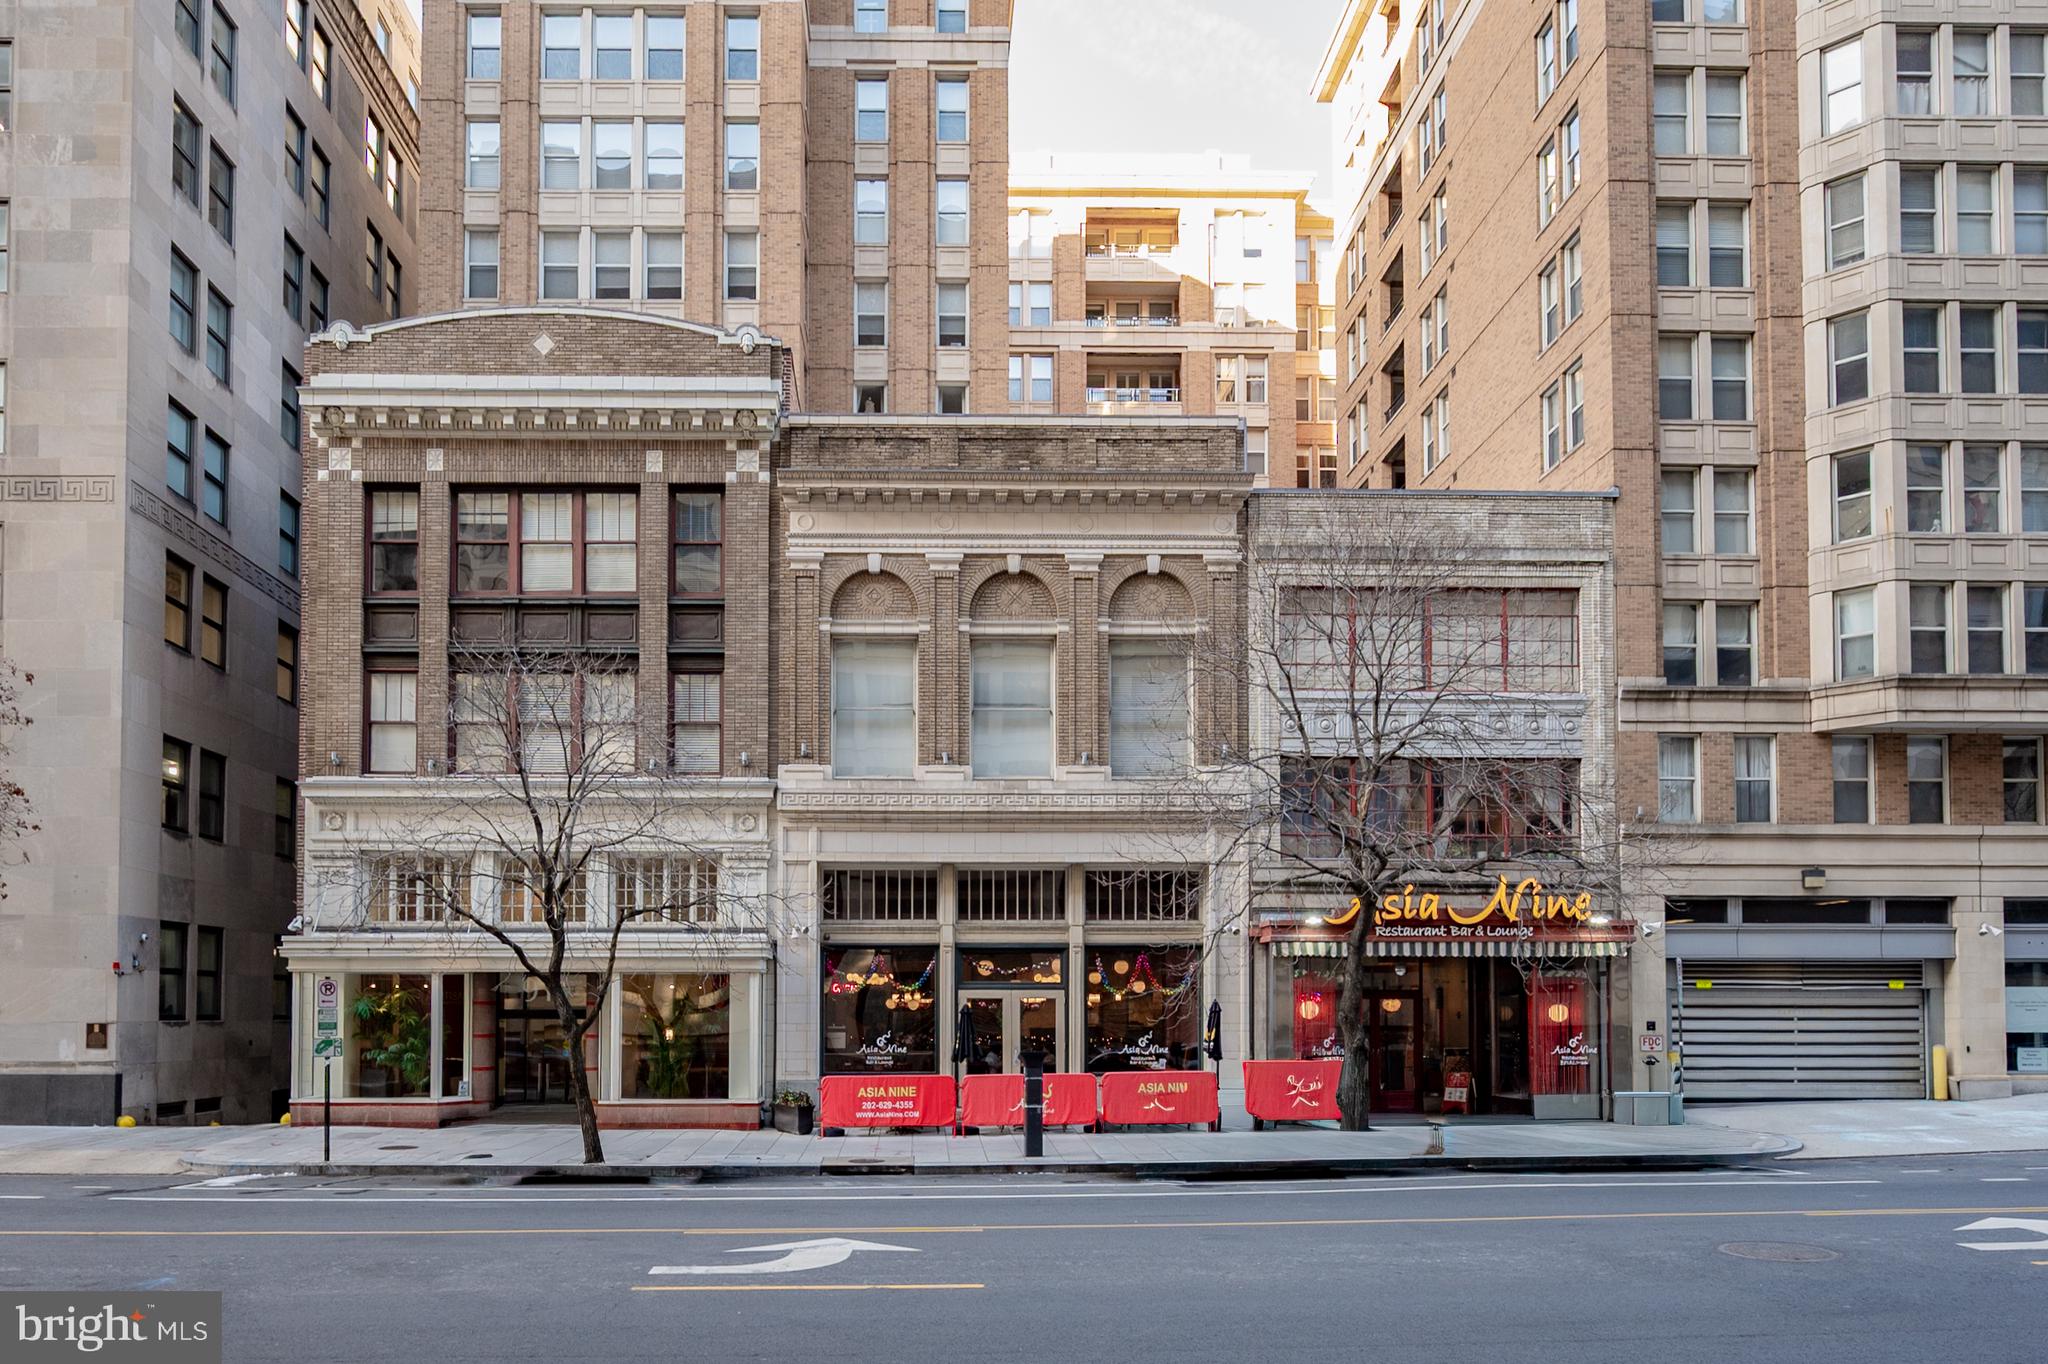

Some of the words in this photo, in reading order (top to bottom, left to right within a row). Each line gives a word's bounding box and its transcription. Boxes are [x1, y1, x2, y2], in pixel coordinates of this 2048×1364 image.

[1323, 883, 1440, 925] Asia
[1447, 873, 1592, 925] Nine
[1375, 925, 1447, 937] Restaurant
[1450, 925, 1473, 937] Bar
[1475, 926, 1484, 937] &
[1487, 925, 1534, 940] Lounge
[1642, 1037, 1661, 1047] FDC
[879, 1044, 907, 1054] Nine
[858, 1087, 886, 1098] ASIA
[888, 1086, 917, 1097] NINE
[1137, 1082, 1165, 1093] ASIA
[862, 1101, 914, 1109] 202-629-4355
